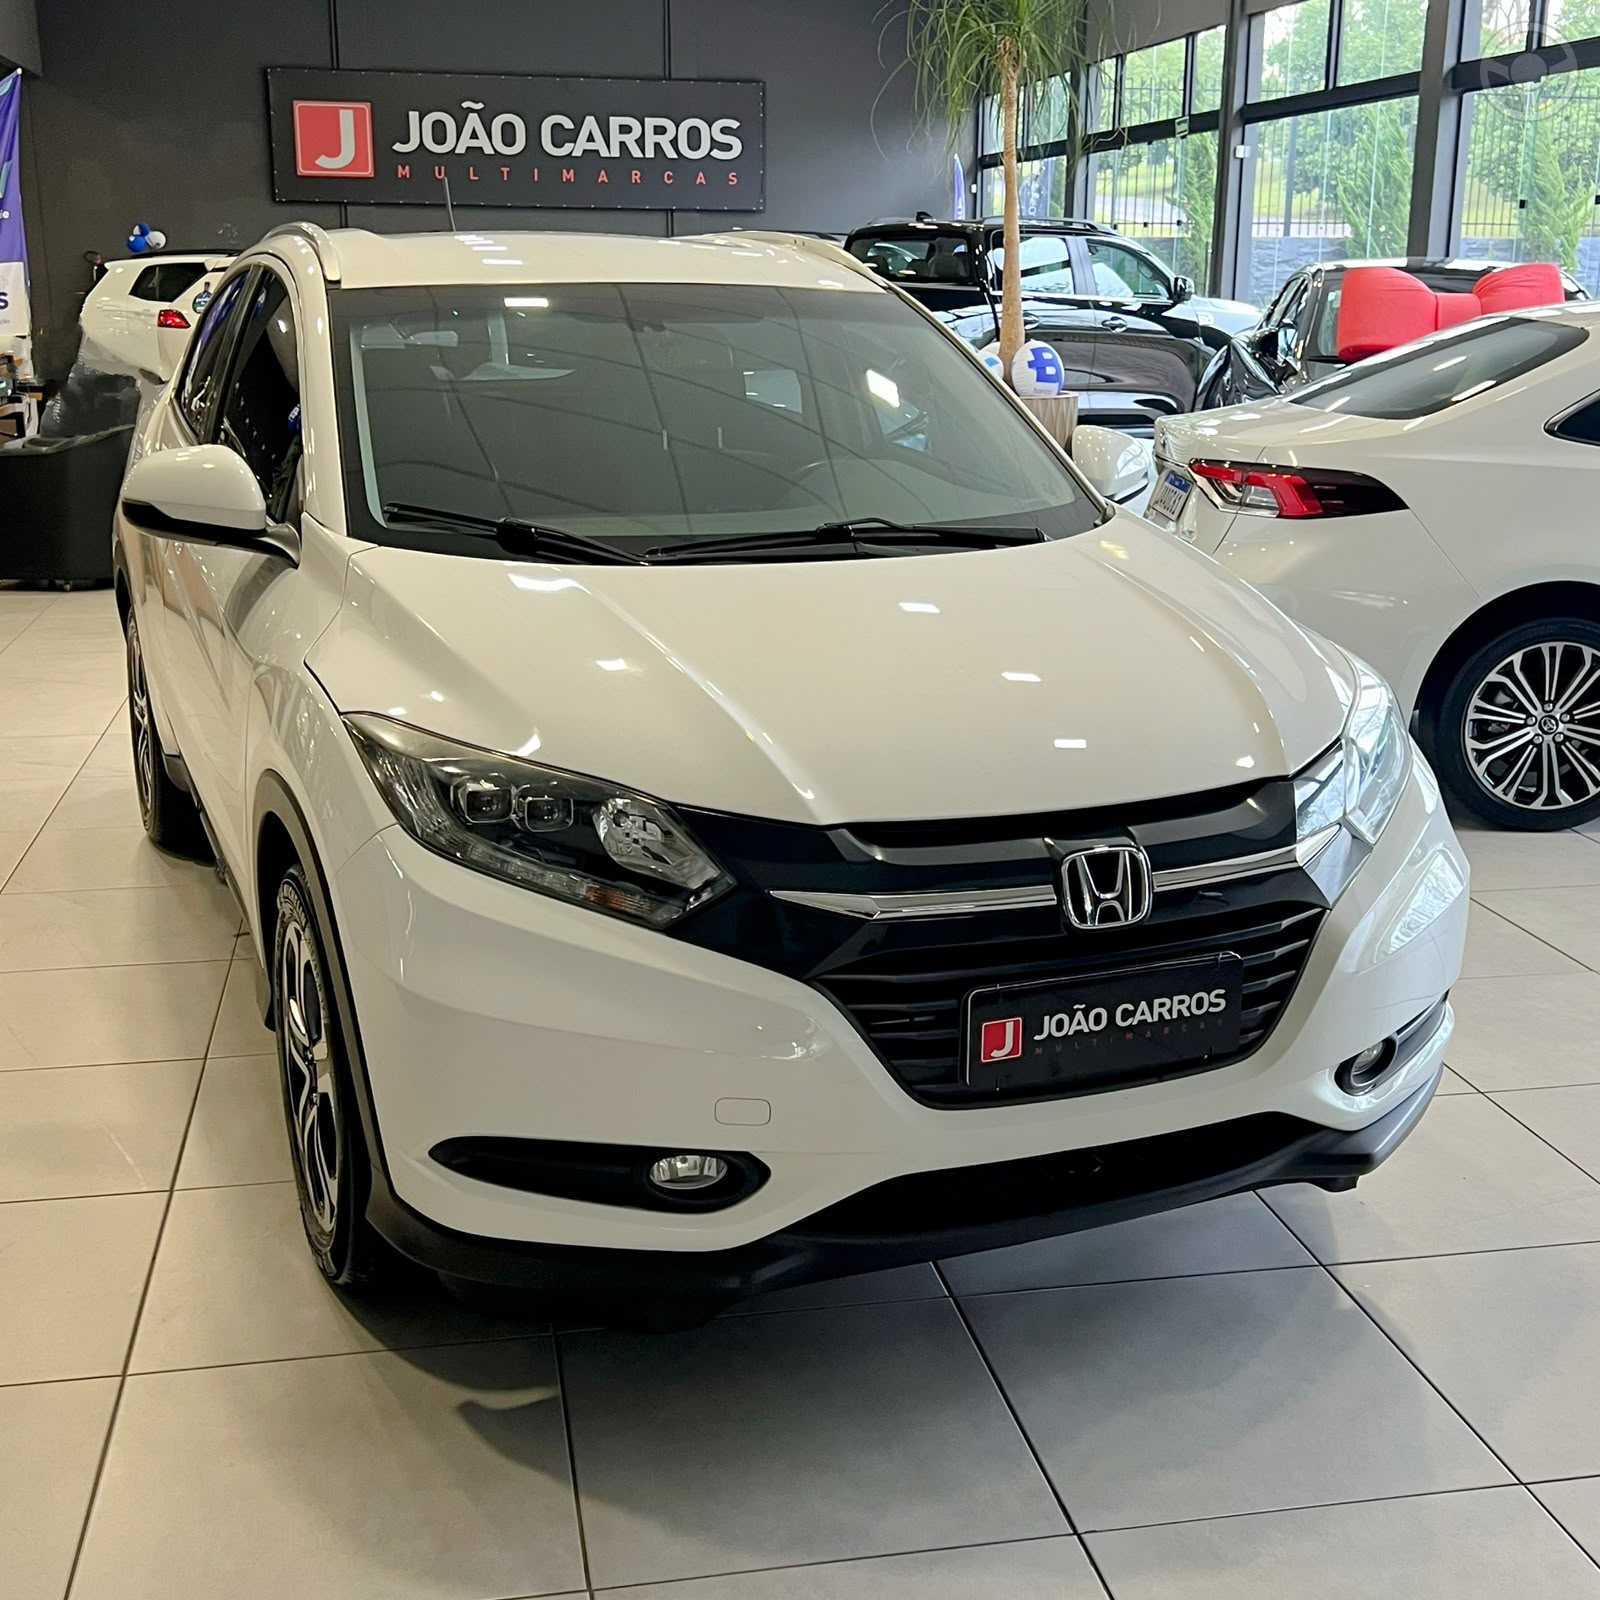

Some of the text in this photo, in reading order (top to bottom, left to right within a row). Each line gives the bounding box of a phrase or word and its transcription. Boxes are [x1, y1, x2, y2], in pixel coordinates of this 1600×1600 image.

[314, 108, 356, 170] J
[391, 100, 743, 161] JOÃO CARROS
[397, 164, 739, 186] MULTIMARCAS
[990, 1020, 1015, 1058] J
[1033, 988, 1227, 1041] JOÃO CARROS
